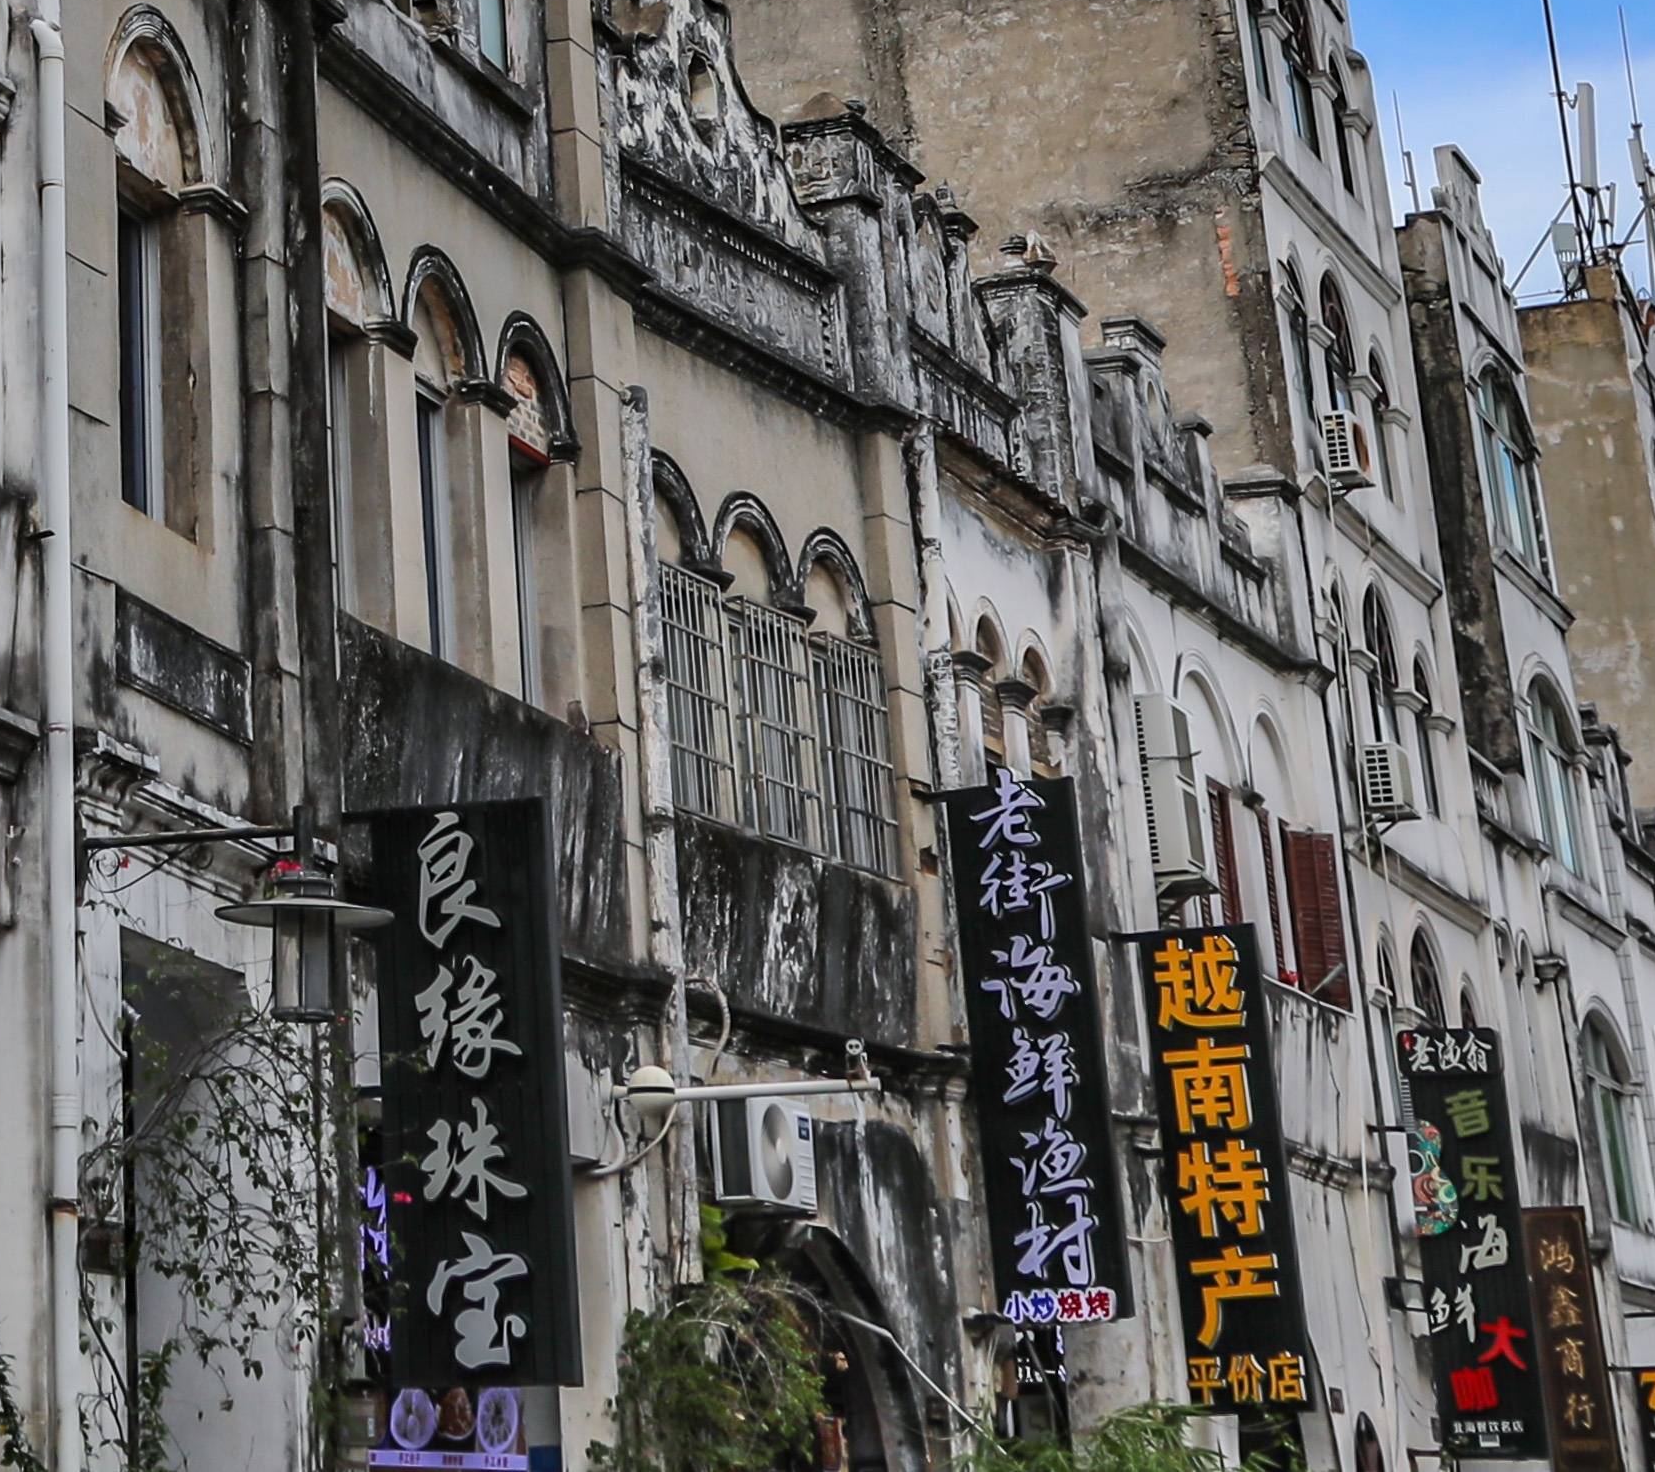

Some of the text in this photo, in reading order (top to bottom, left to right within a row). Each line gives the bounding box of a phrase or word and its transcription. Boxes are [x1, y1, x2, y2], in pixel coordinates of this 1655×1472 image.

[414, 812, 527, 1370] 良缘珠宝
[969, 765, 1098, 1284] 老街海鲜渔村
[1152, 935, 1279, 1348] 越南特产
[1004, 1286, 1116, 1324] 小炒烧烤
[1187, 1351, 1306, 1403] 平价店
[1539, 1237, 1597, 1430] 鸿鑫商行
